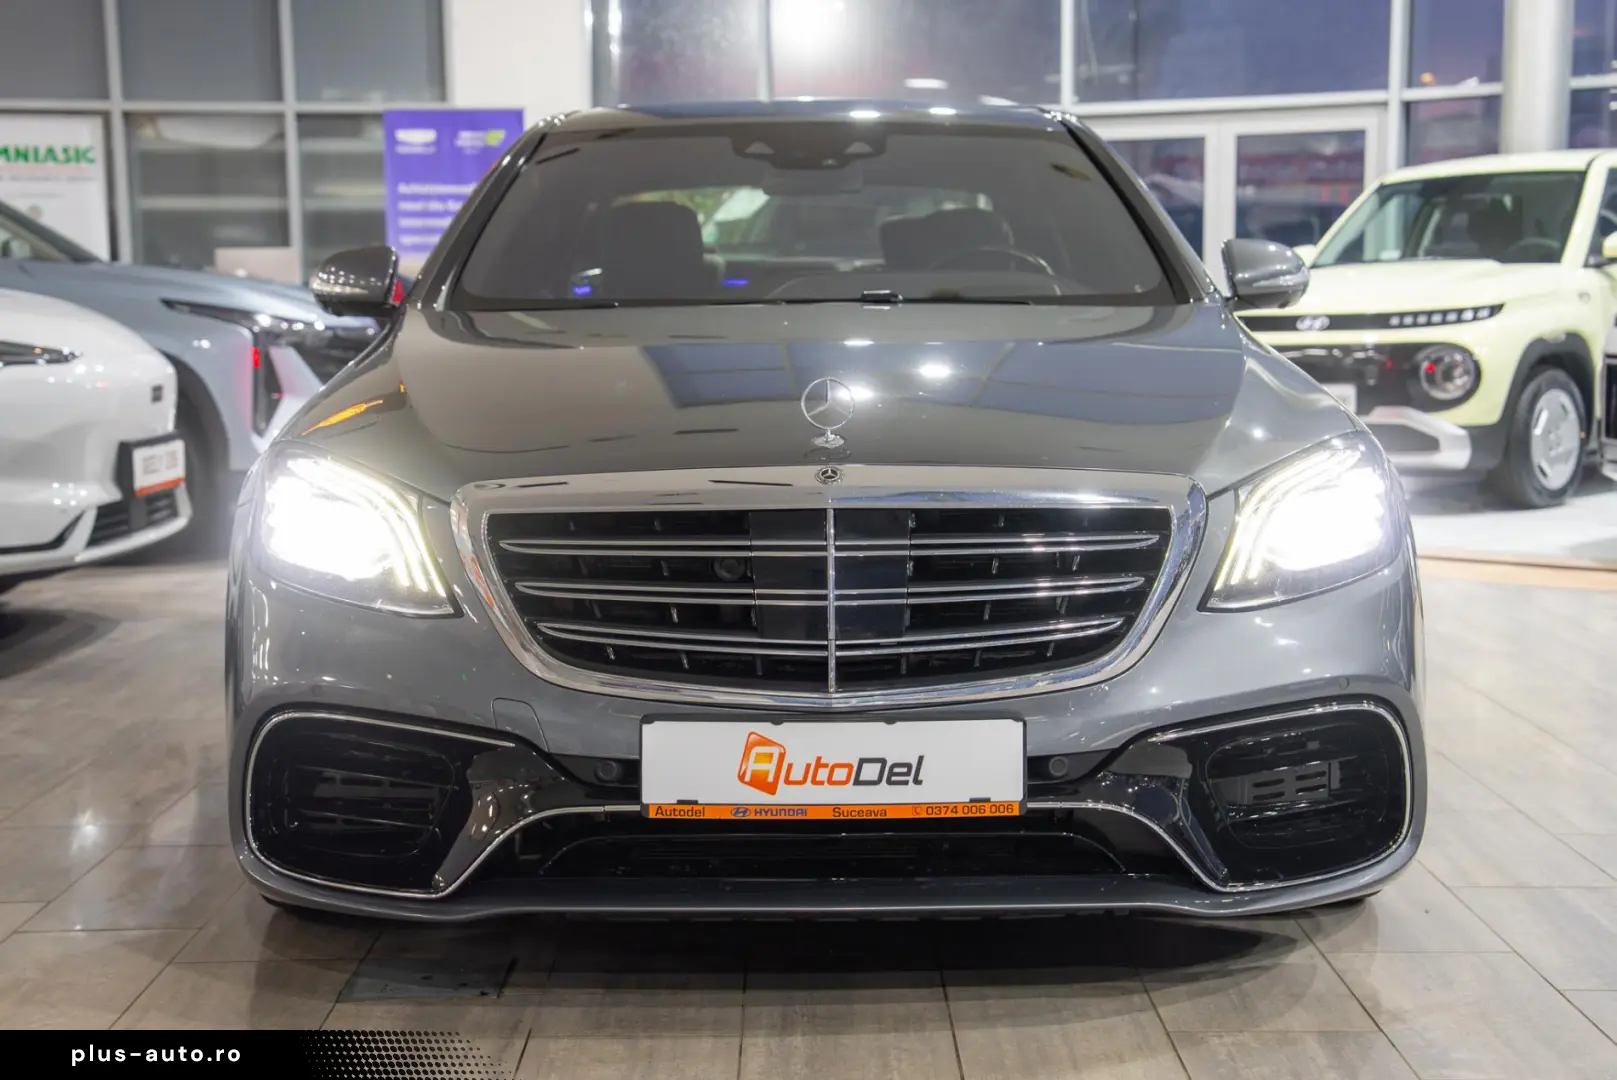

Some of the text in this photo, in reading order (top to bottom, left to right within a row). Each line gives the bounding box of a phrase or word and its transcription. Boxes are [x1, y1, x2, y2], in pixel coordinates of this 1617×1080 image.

[741, 741, 924, 787] AutoDel
[655, 803, 1014, 818] Autodel HYUNDAI Suceava 0374 006 006
